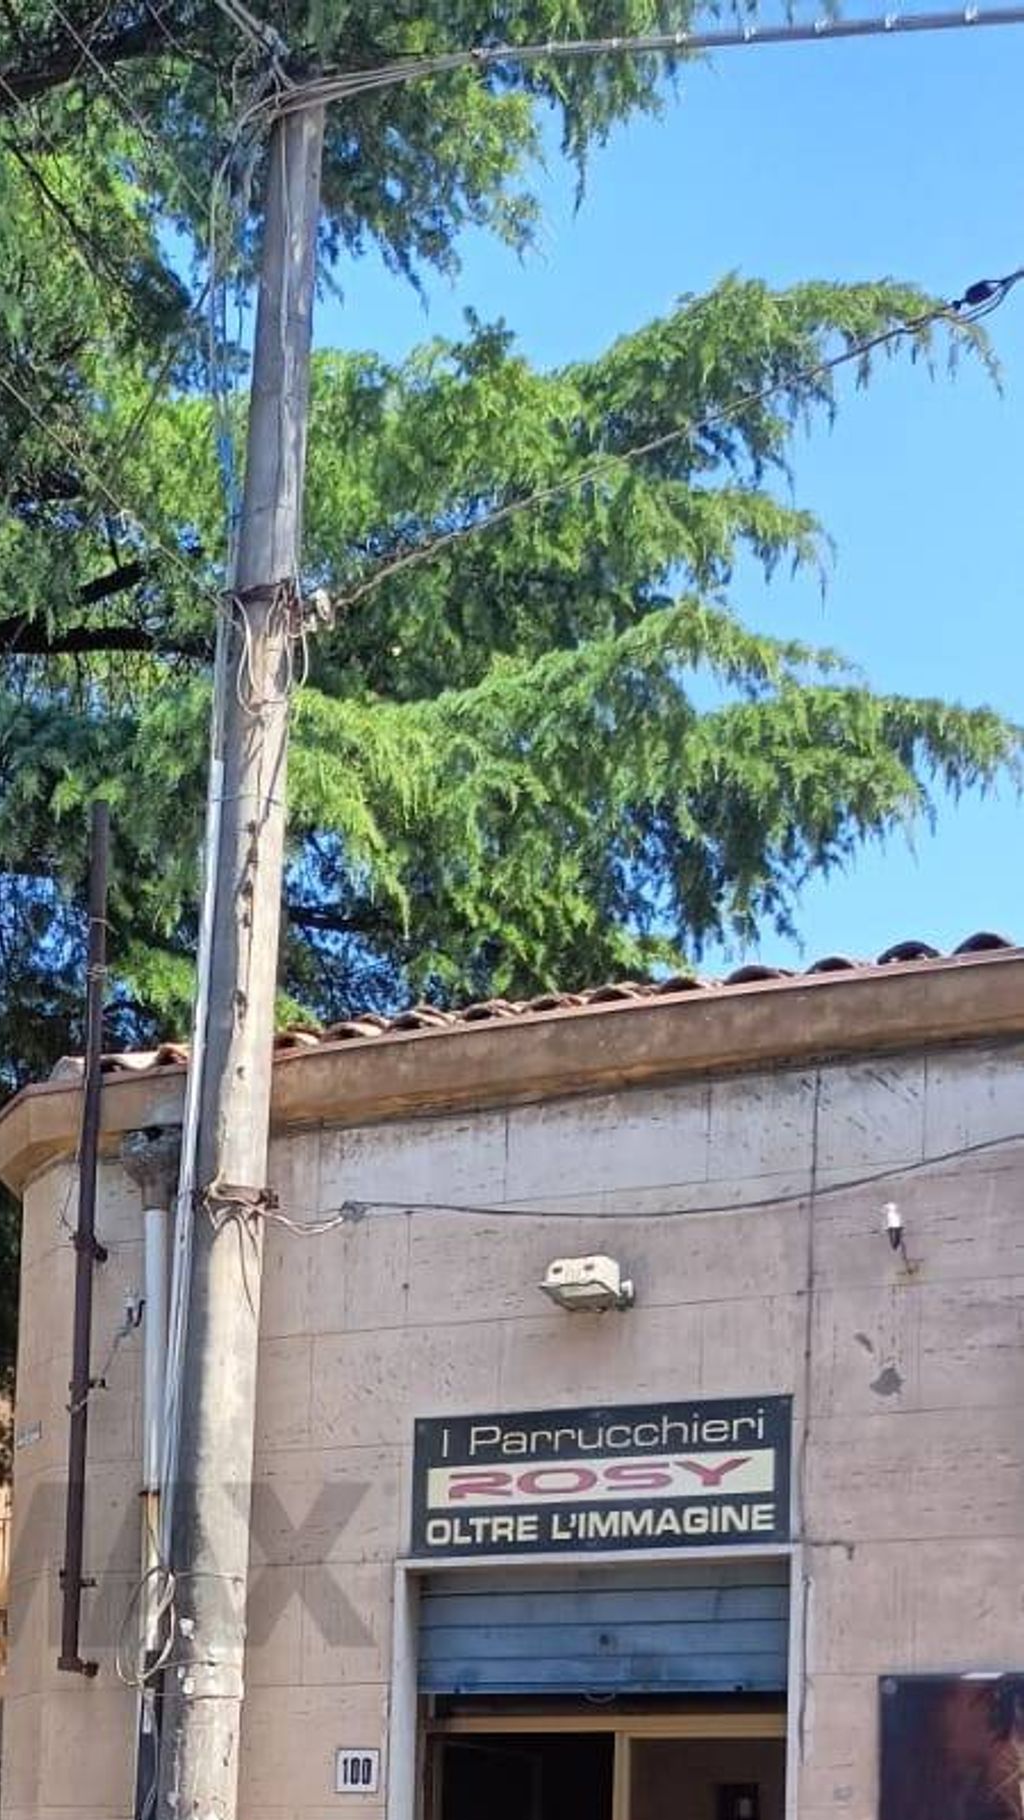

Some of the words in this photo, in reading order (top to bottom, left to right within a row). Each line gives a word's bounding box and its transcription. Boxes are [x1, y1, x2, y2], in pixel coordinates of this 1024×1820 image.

[441, 1428, 450, 1458] I
[468, 1407, 765, 1456] Parrucchieri
[448, 1456, 753, 1499] ROSY
[426, 1514, 539, 1546] OLTRE
[550, 1503, 776, 1541] L'IMMAGINE
[342, 1756, 373, 1786] 100
